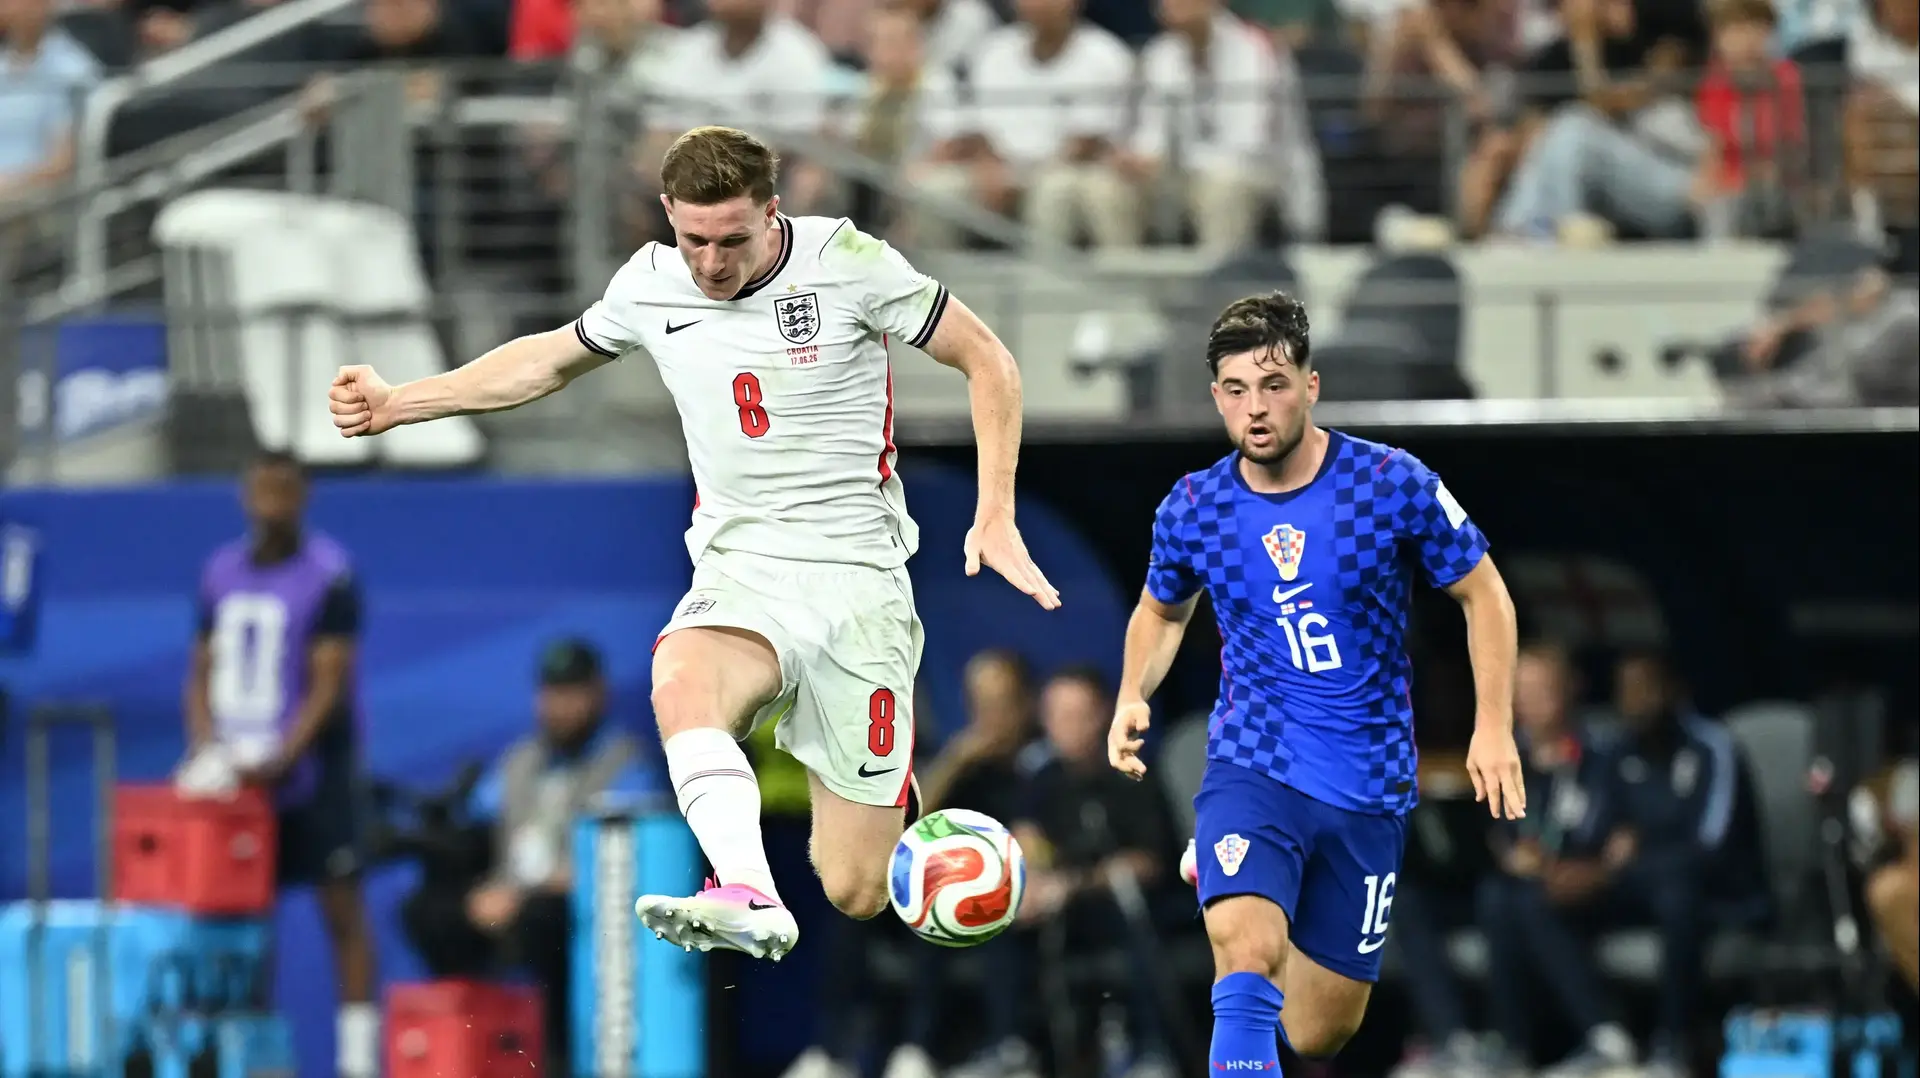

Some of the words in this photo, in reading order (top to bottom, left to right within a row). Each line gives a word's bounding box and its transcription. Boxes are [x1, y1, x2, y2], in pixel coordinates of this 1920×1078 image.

[786, 345, 819, 356] CROATIA
[791, 354, 818, 366] 17.06.26
[732, 371, 771, 439] 8
[1276, 612, 1343, 673] 16
[868, 687, 895, 757] 8
[1361, 871, 1396, 935] 16
[1226, 1059, 1263, 1070] HNS
